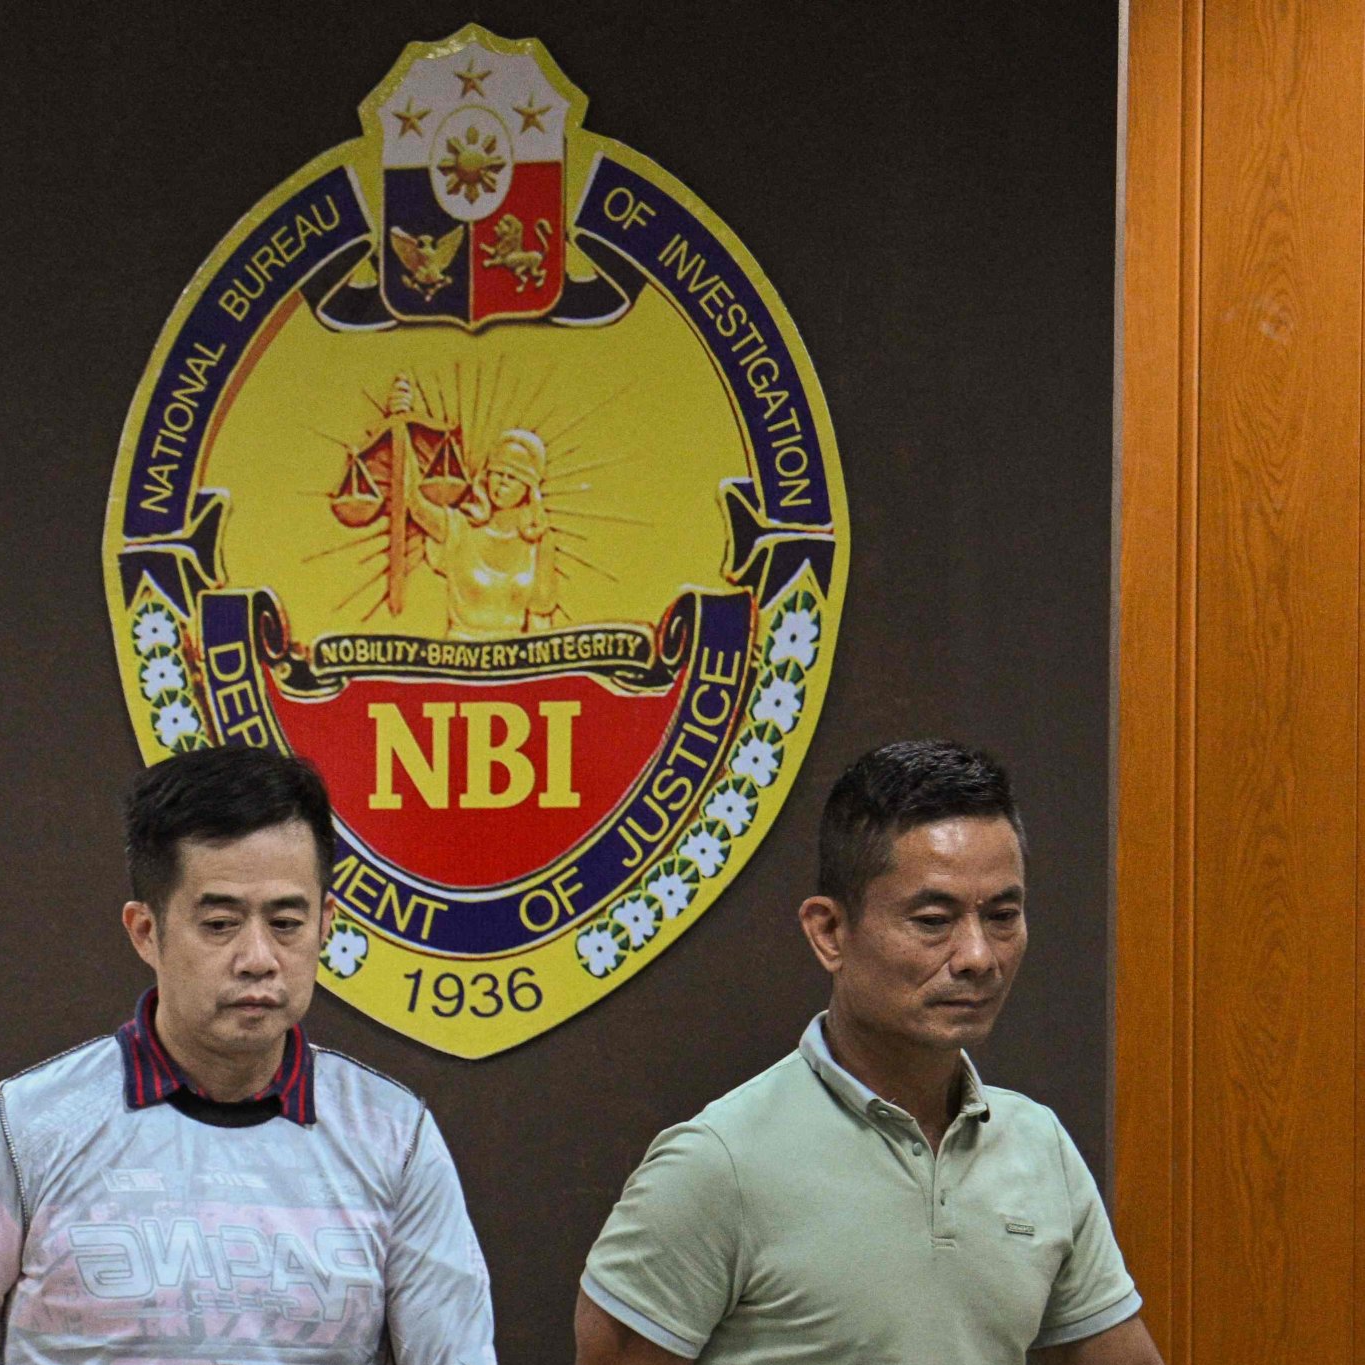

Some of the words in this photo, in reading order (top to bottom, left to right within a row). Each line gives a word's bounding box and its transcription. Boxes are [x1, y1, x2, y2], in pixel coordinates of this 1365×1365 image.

[140, 342, 227, 514] NATIONAL
[218, 194, 341, 322] BUREAU
[603, 187, 657, 230] OF
[658, 233, 812, 507] INVESTIGATION
[368, 700, 582, 810] NBI
[519, 866, 585, 933] OF
[617, 646, 742, 868] JUSTICE
[403, 966, 543, 1018] 1936
